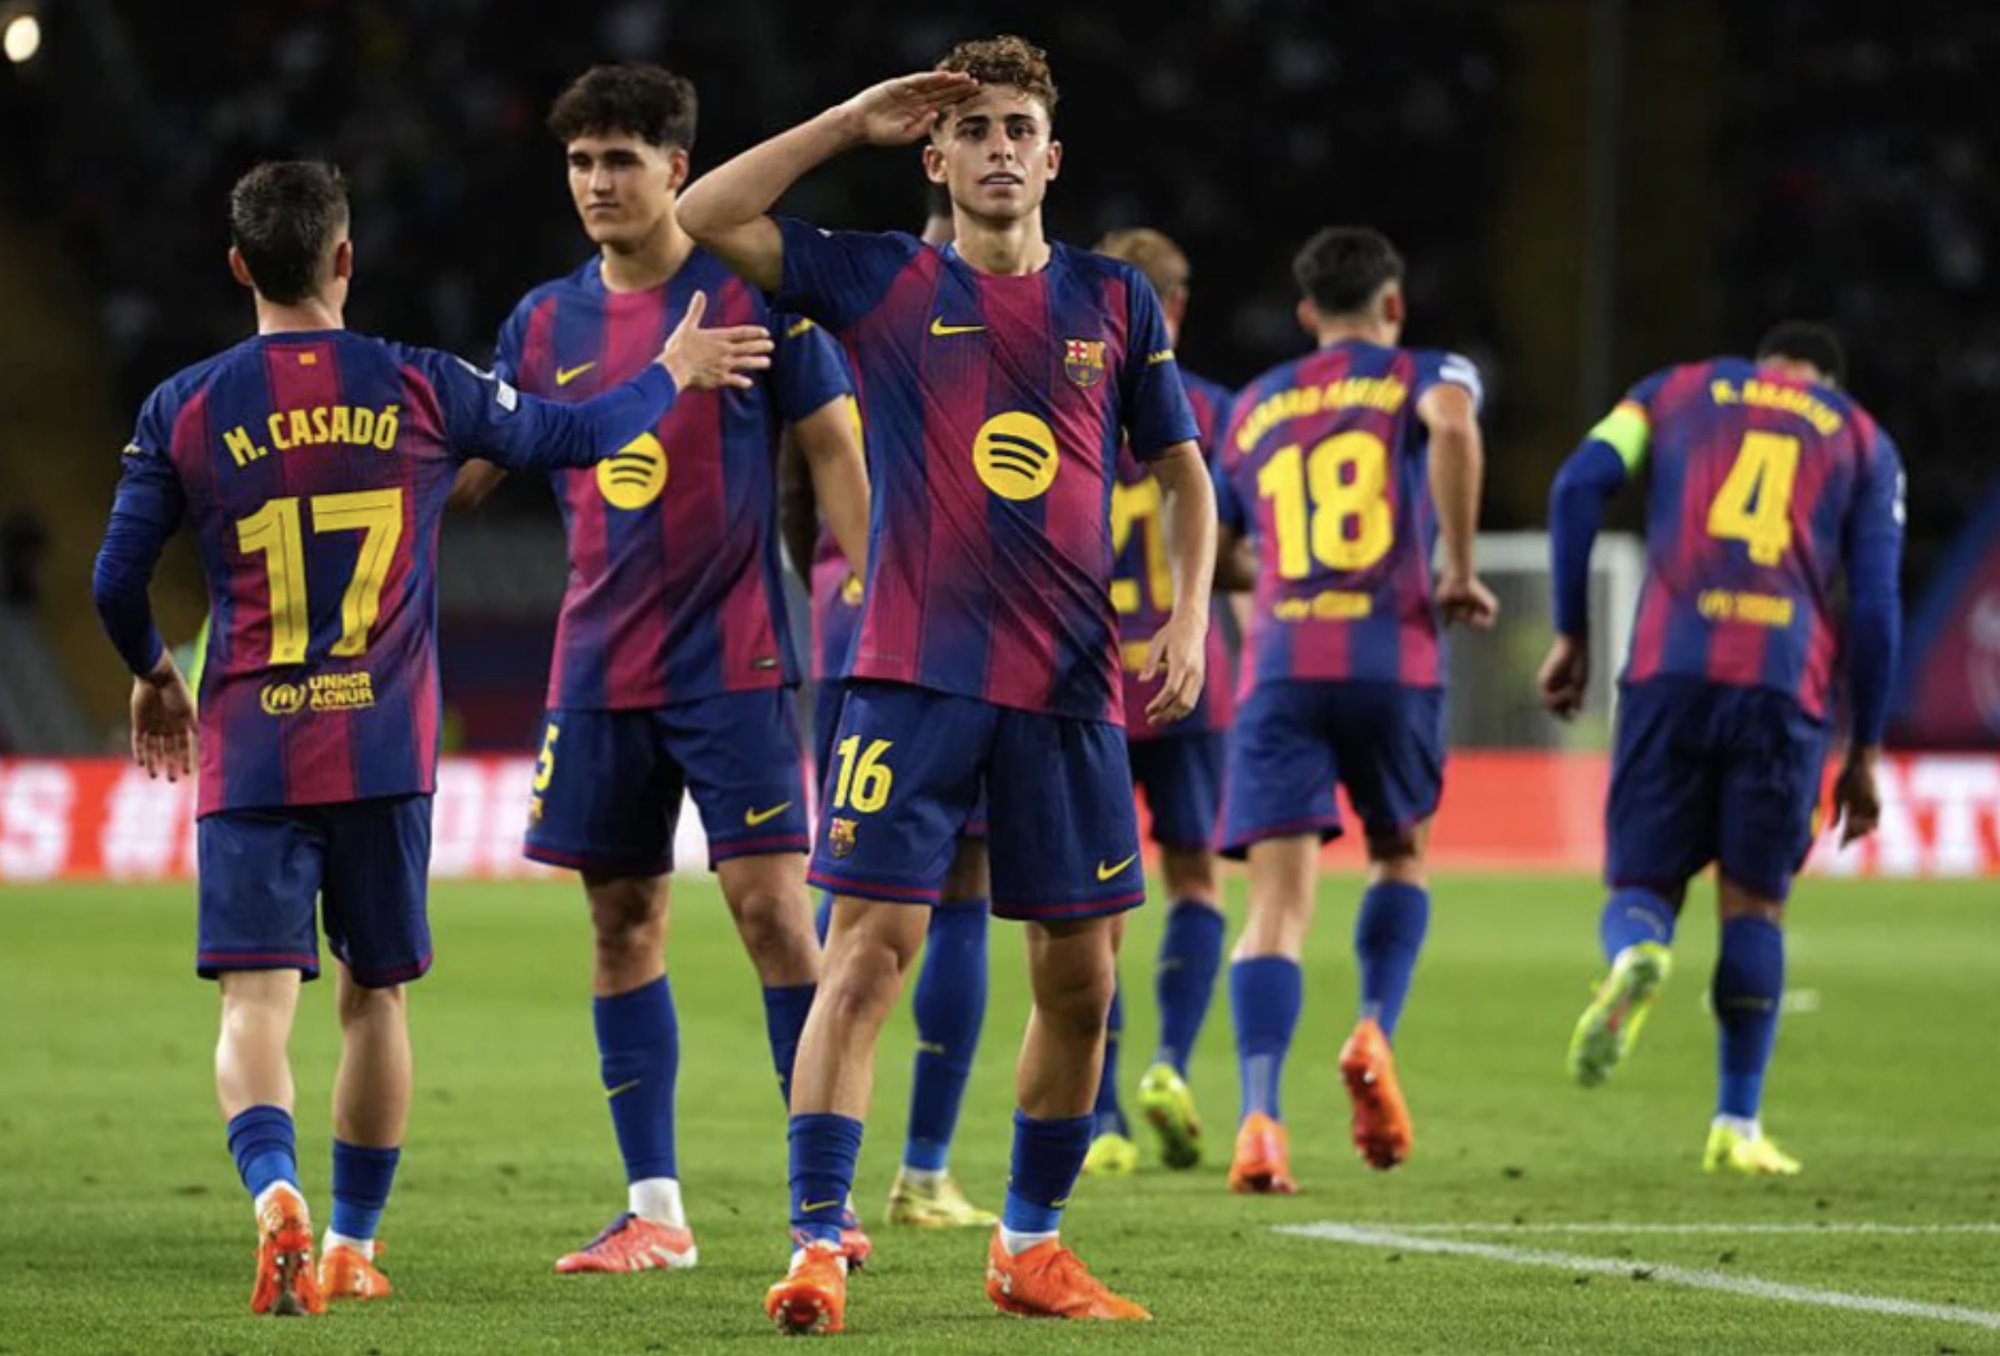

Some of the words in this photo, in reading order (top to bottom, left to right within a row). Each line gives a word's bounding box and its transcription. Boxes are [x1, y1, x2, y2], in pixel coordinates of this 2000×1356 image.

[267, 404, 400, 451] CASADÓ
[1257, 429, 1394, 579] 18
[1707, 430, 1800, 567] 4
[236, 487, 403, 664] 17
[308, 671, 371, 690] UNHCR
[310, 687, 374, 707] ACNUR
[534, 722, 560, 791] 5
[833, 734, 894, 813] 16
